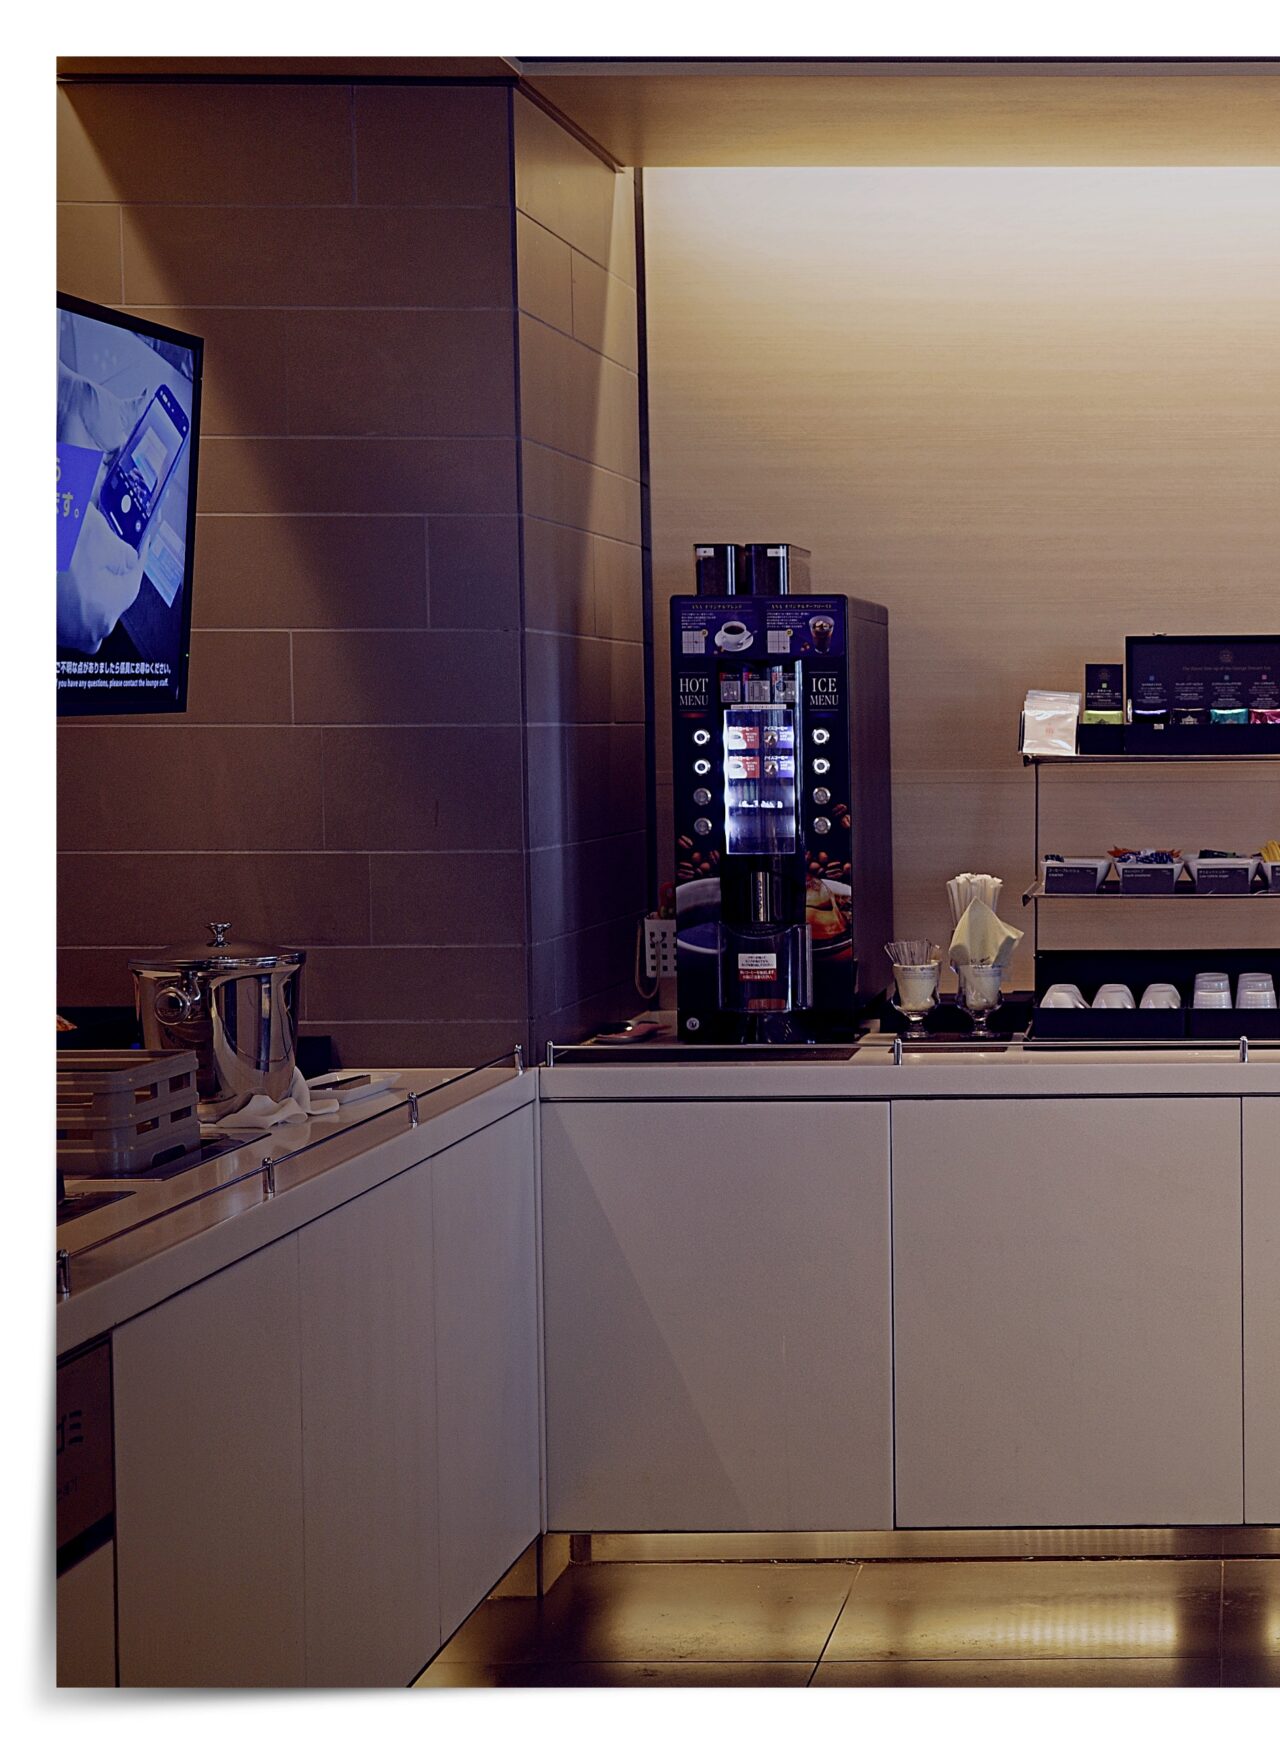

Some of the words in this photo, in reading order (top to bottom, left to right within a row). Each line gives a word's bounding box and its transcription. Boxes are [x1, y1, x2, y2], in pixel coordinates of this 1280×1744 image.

[56, 491, 80, 518] す。
[67, 678, 78, 687] have
[679, 677, 709, 693] HOT
[811, 677, 837, 693] ICE
[679, 694, 710, 706] MENU
[810, 694, 839, 706] MENU
